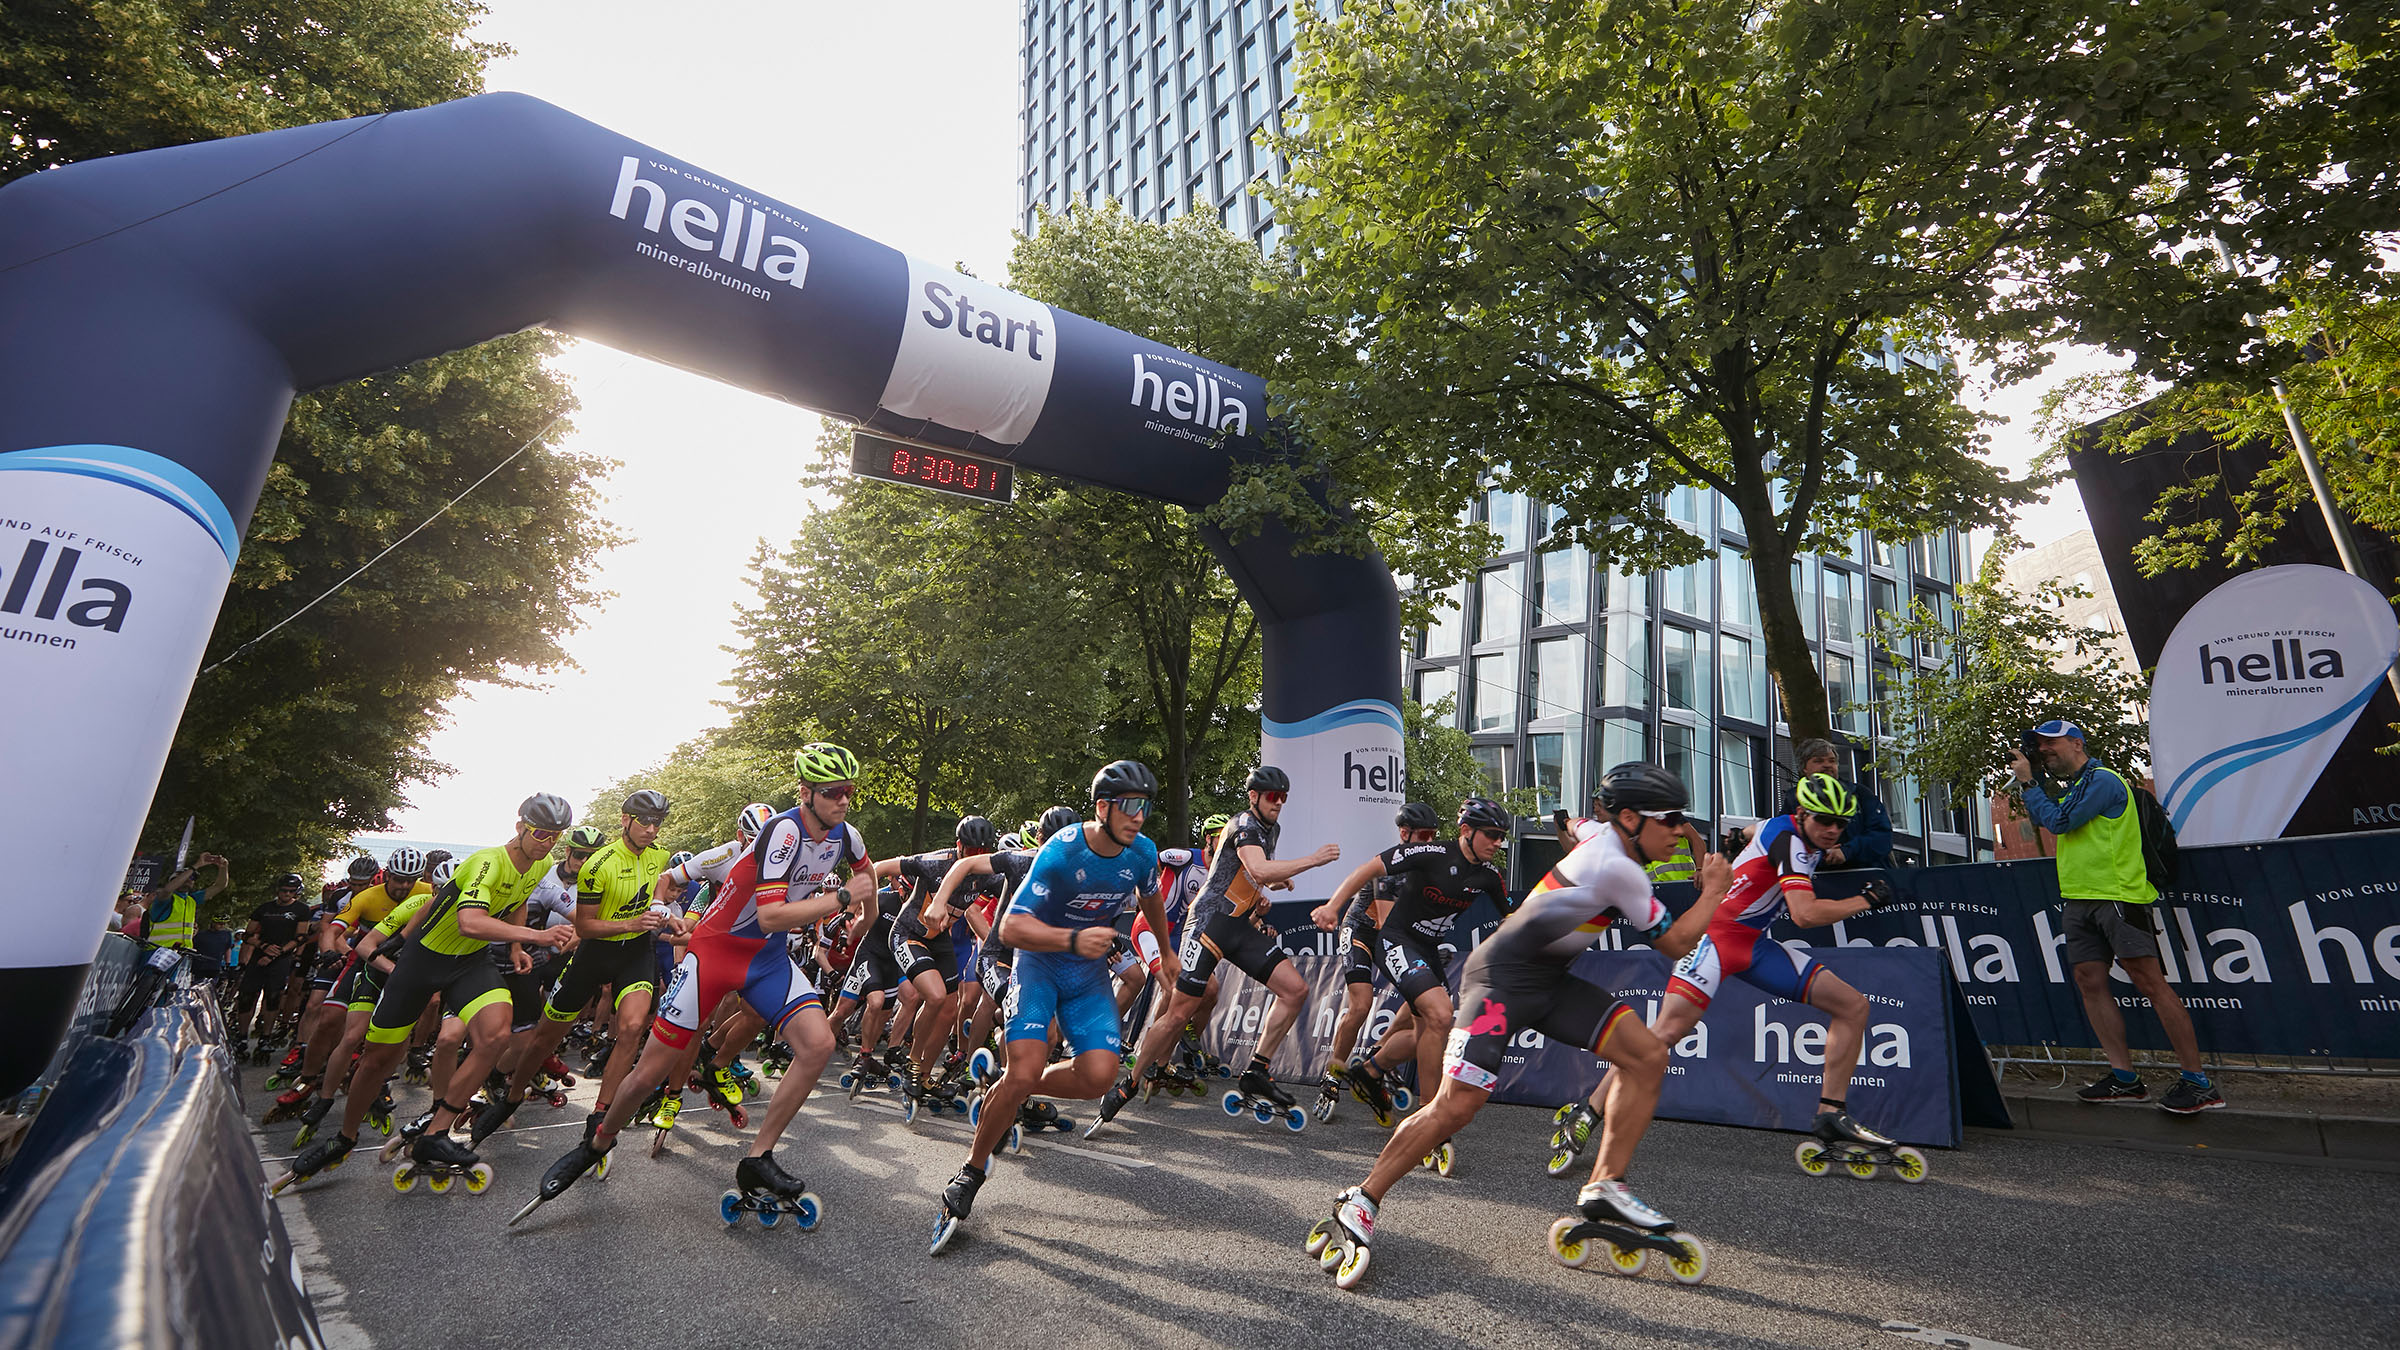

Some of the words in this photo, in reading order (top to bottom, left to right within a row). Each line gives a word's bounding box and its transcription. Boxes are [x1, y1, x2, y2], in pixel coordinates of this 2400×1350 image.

[649, 159, 679, 176] VON
[684, 172, 730, 194] GRUND
[735, 192, 760, 207] AUF
[764, 205, 810, 233] FRISCH
[609, 155, 811, 290] hella
[636, 240, 772, 302] mineralbrunnen
[922, 280, 1044, 362] Start
[1145, 353, 1165, 362] VON
[1165, 357, 1193, 369] GRUND
[1195, 366, 1211, 376] AUF
[1213, 373, 1243, 390] FRISCH
[1130, 353, 1248, 438] hella
[1144, 419, 1225, 450] mineralbrunen
[892, 449, 998, 492] 8:30:01
[40, 526, 79, 541] AUF
[84, 537, 144, 567] FRISCH
[0, 538, 133, 634] lla
[2214, 636, 2235, 646] VON
[2237, 631, 2271, 641] GRUND
[2274, 629, 2294, 637] AUF
[2297, 629, 2336, 639] FRISCH
[2199, 638, 2345, 685] hella
[2226, 684, 2324, 697] mineralbrunnen
[1404, 844, 1447, 858] Rollerblade
[2183, 892, 2243, 907] FRISCH
[2315, 888, 2354, 903] VON
[2361, 881, 2400, 895] GRU
[1483, 920, 1499, 930] VON
[1851, 909, 1873, 920] VON
[1877, 902, 1917, 914] GRUND
[1922, 901, 1945, 911] AUF
[1951, 902, 1998, 916] FRISCH
[895, 946, 911, 969] 258
[1185, 940, 1199, 968] 257
[2032, 906, 2272, 984] hlla
[1389, 949, 1403, 976] 244
[847, 979, 860, 991] 78
[984, 971, 997, 994] 259
[1618, 989, 1648, 998] GRUND
[1222, 993, 1274, 1034] hel
[1754, 1002, 1911, 1069] hea
